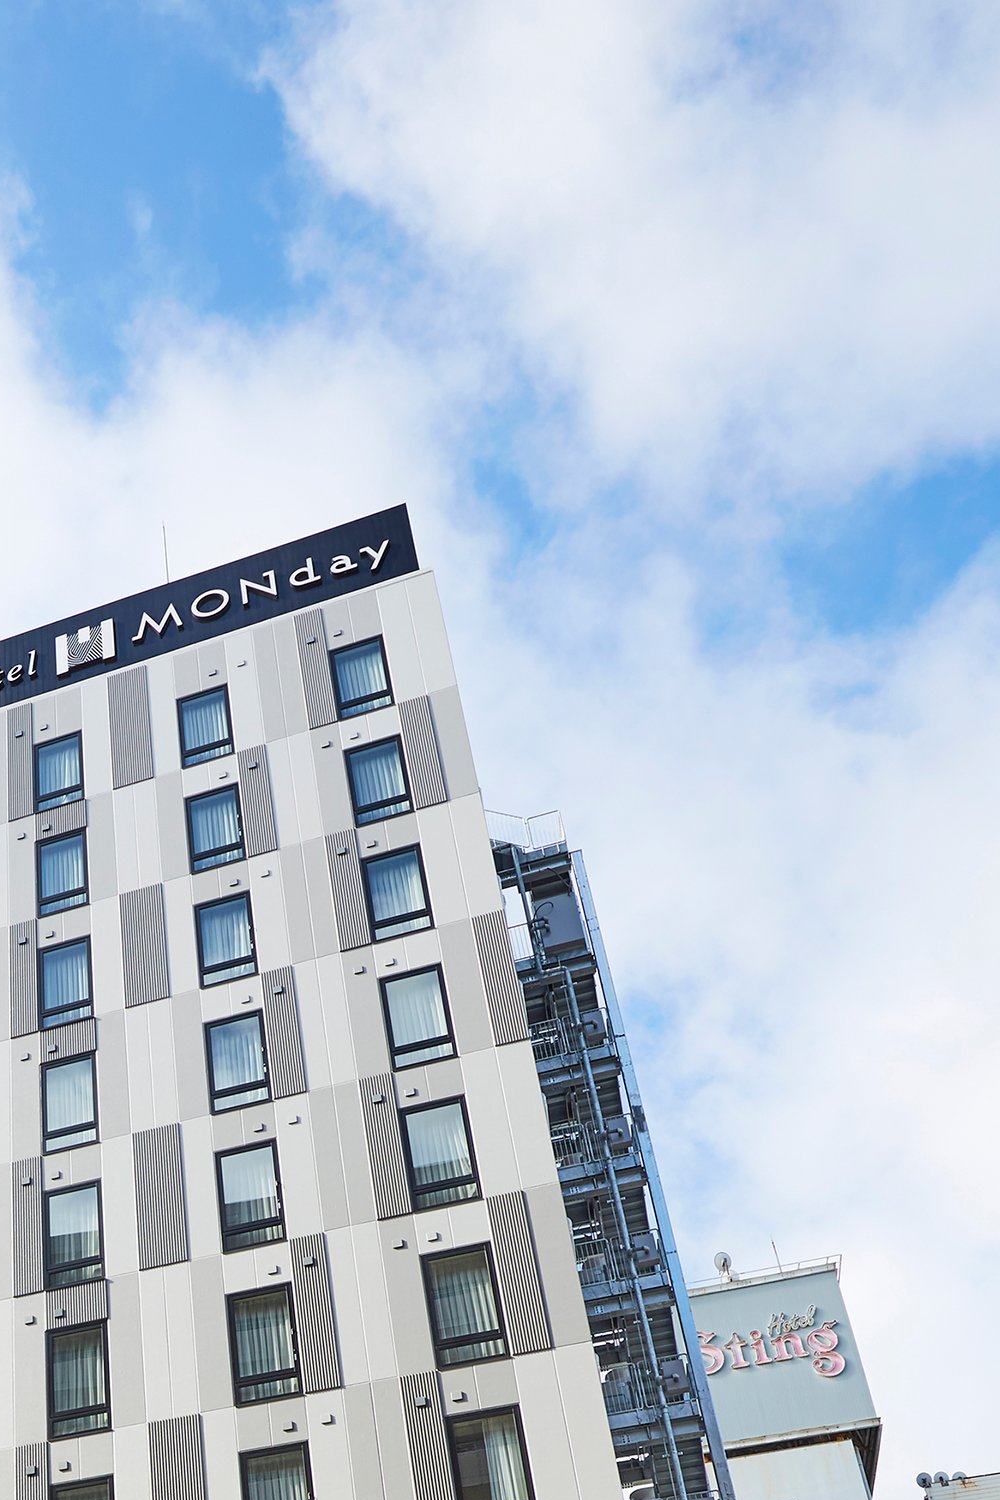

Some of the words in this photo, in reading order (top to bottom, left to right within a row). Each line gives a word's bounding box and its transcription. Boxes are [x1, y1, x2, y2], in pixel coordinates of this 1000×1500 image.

[131, 538, 390, 643] MONday
[696, 1319, 846, 1378] Sting
[767, 1303, 817, 1337] Hotel
